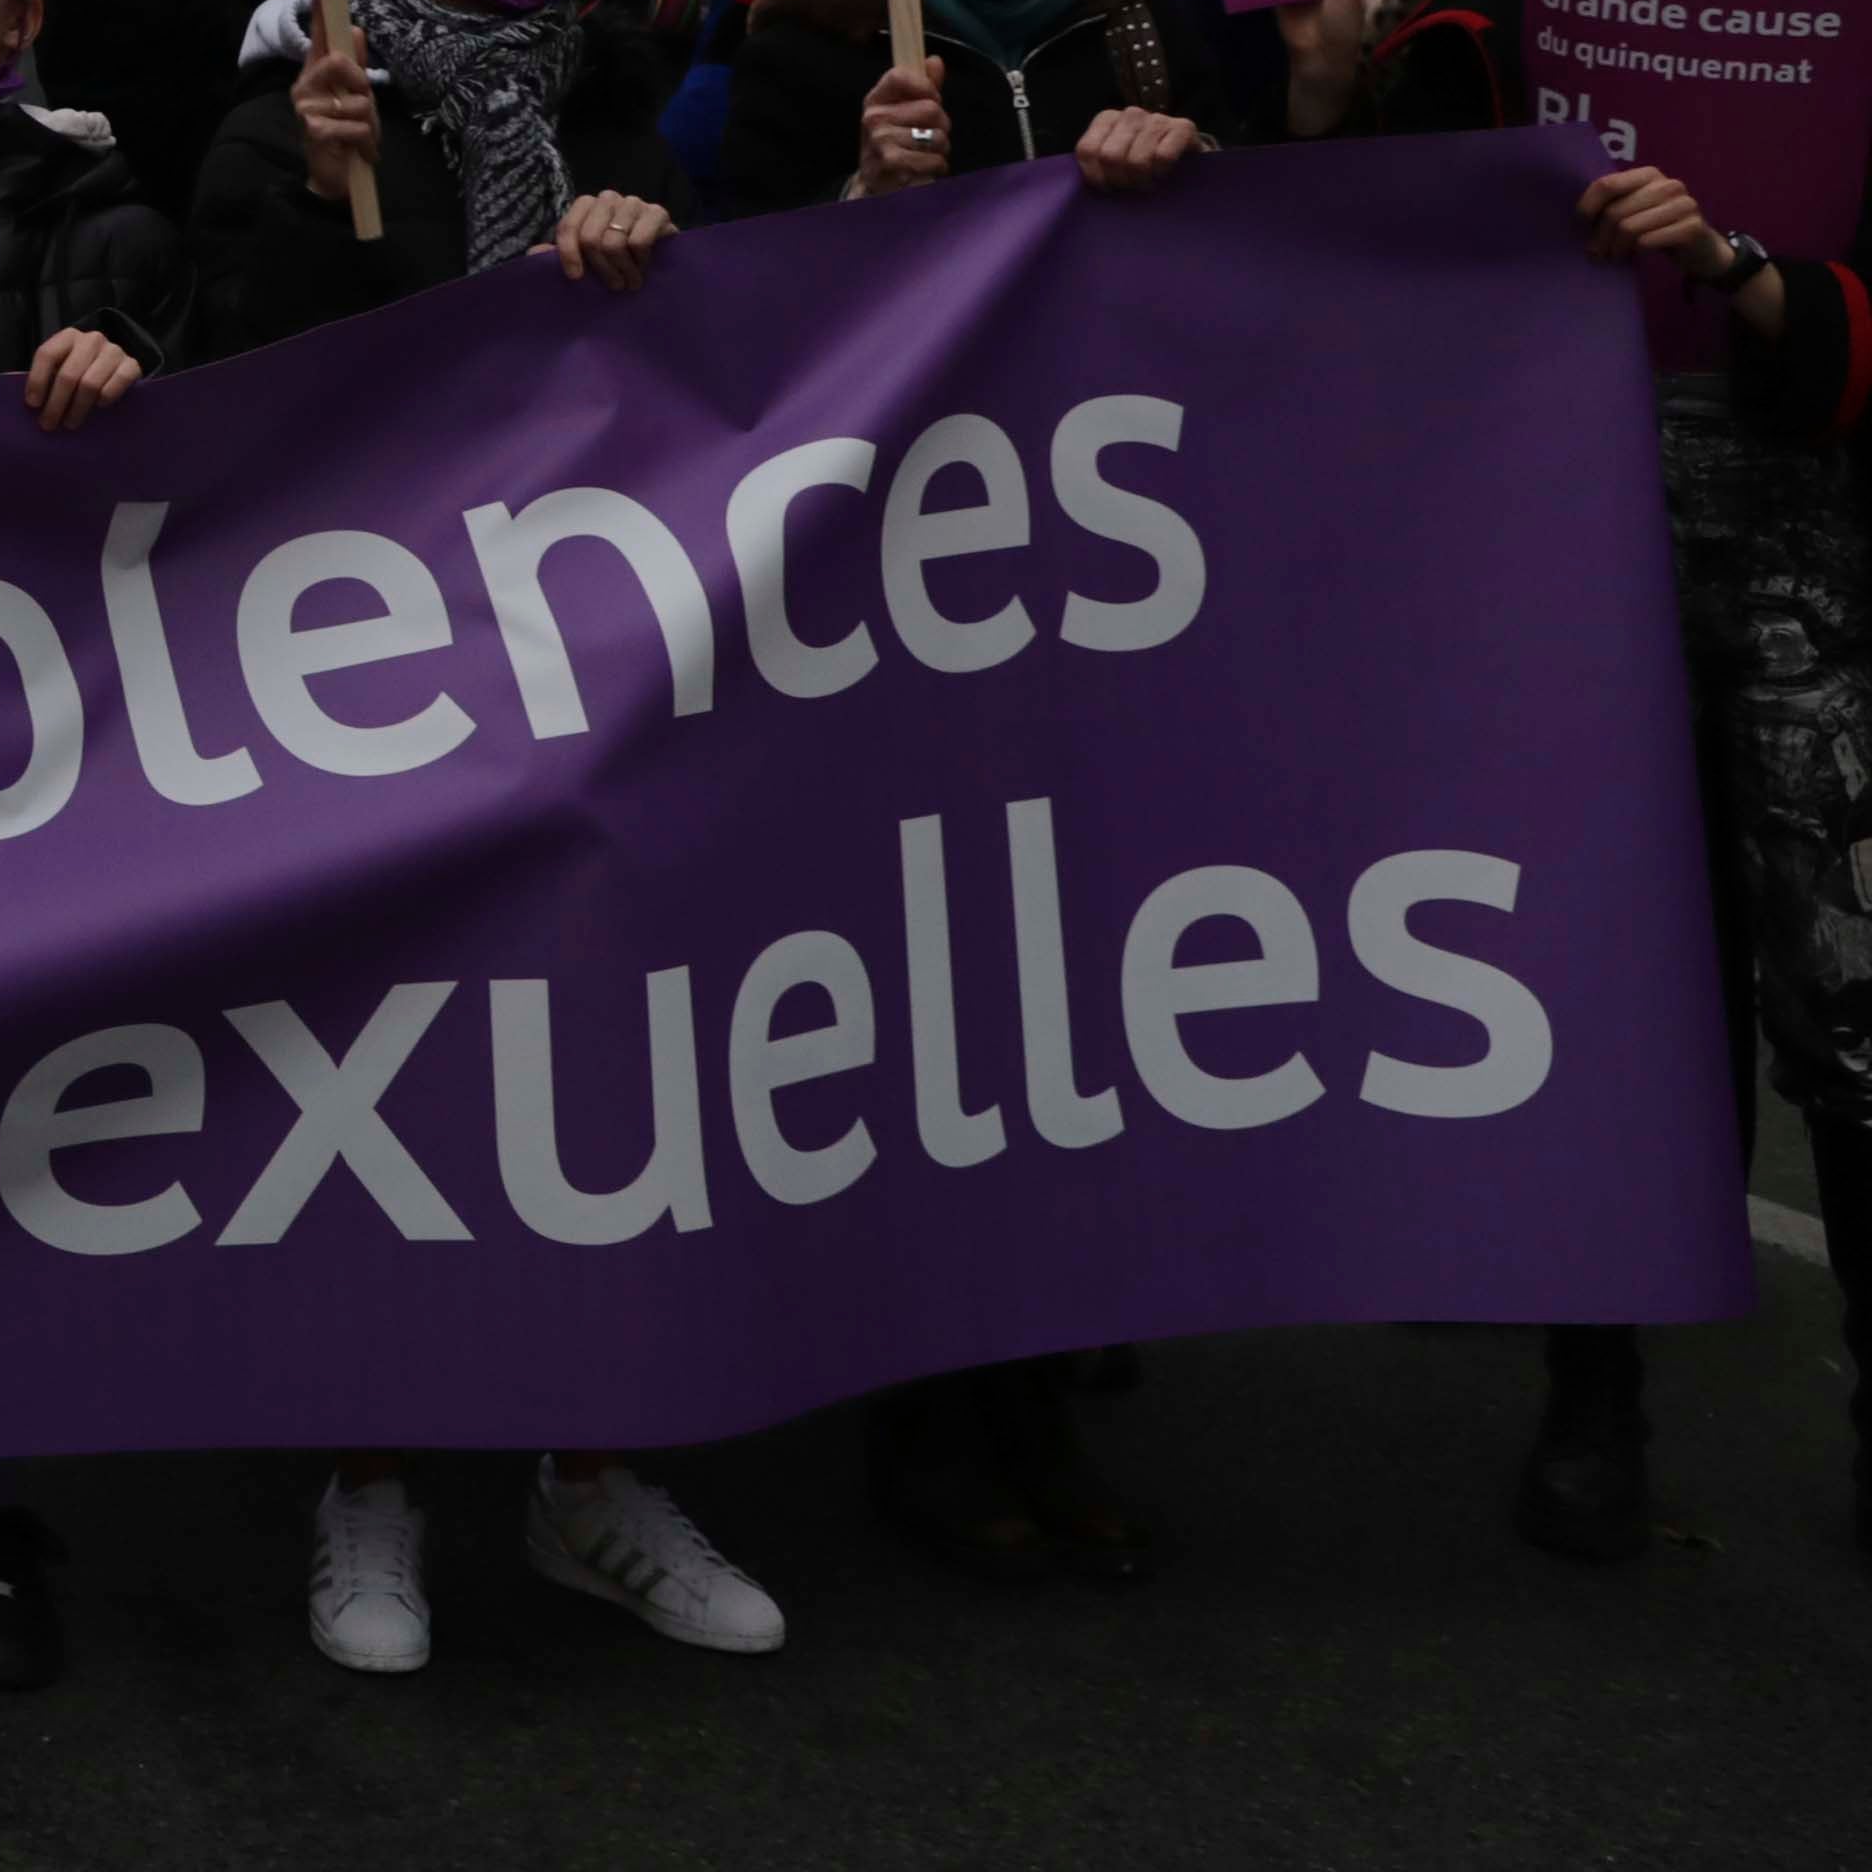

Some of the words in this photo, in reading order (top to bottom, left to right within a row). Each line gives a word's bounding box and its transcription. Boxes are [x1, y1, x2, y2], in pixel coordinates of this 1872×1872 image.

[1698, 7, 1842, 38] cause
[1537, 26, 1568, 57] du
[1574, 42, 1813, 85] quinquennat
